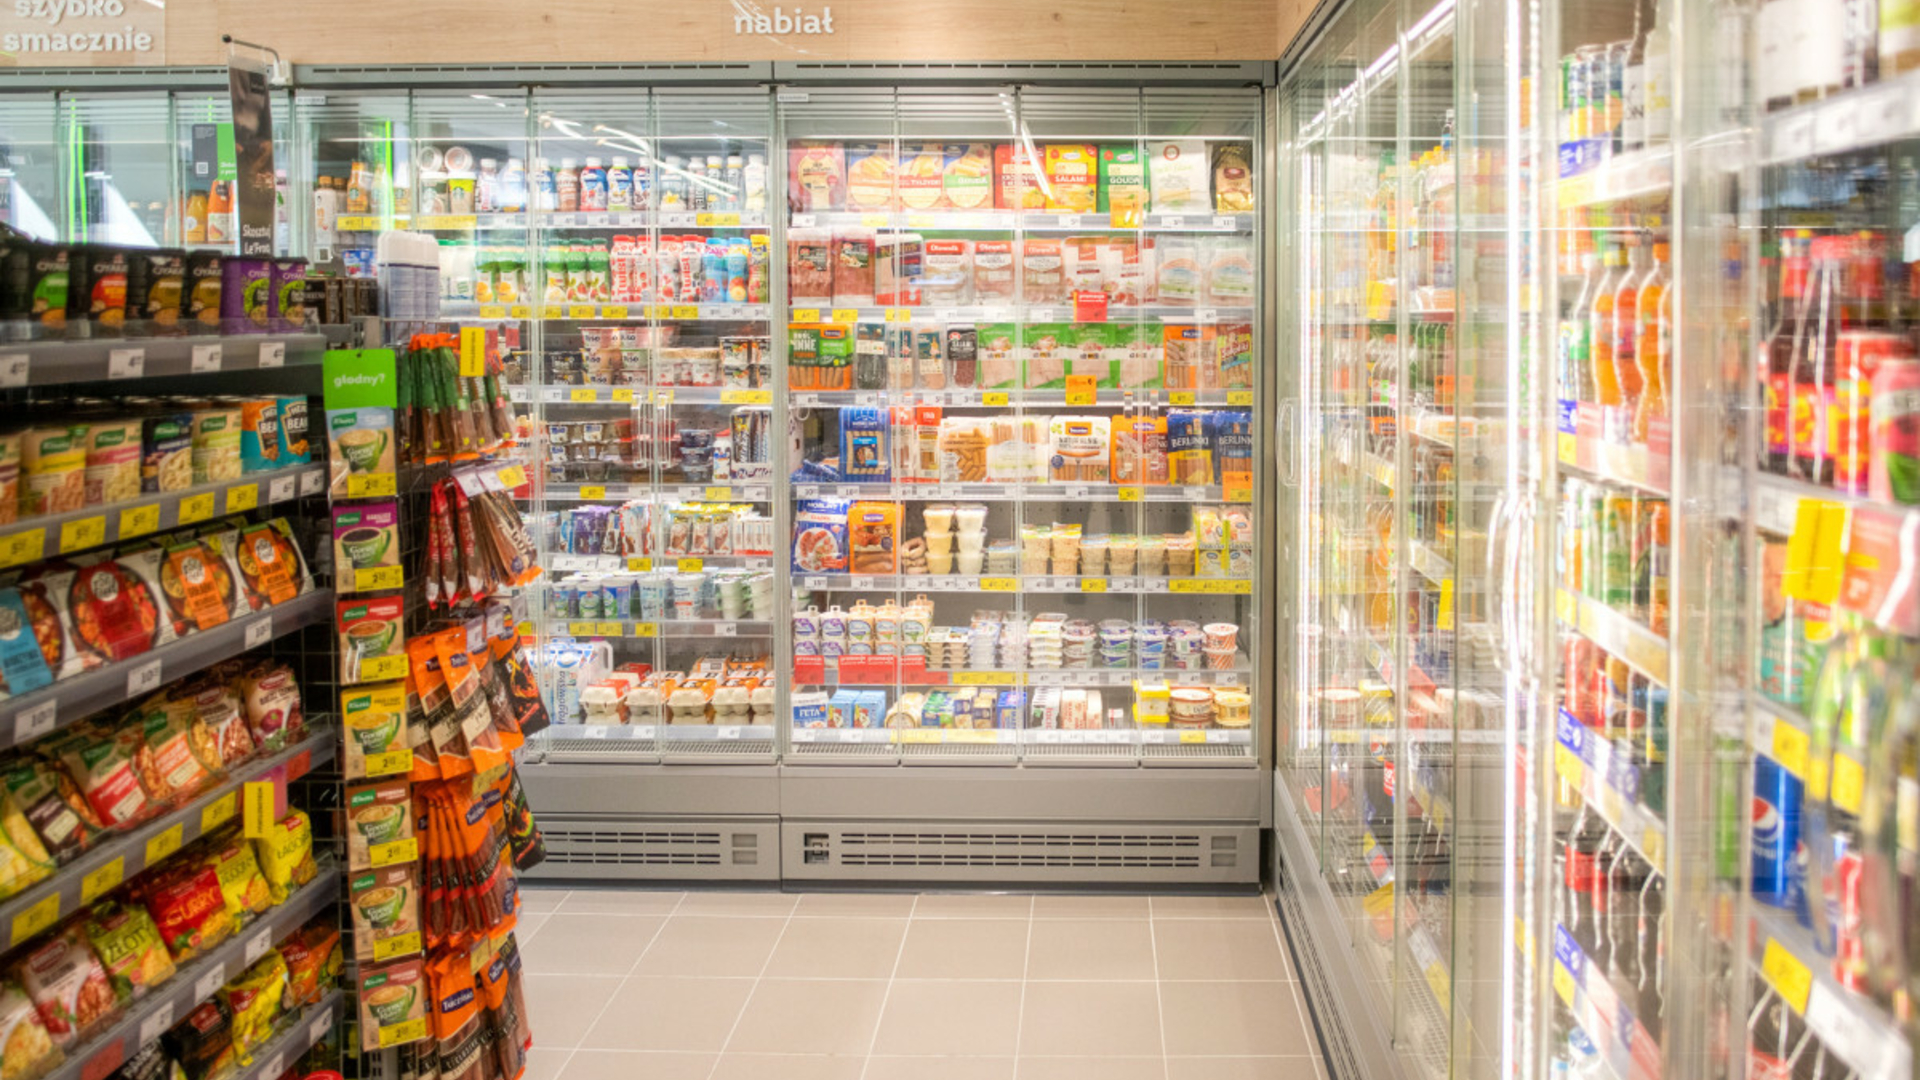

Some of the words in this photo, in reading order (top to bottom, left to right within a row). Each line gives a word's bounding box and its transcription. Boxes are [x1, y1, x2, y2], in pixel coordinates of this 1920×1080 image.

[15, 0, 125, 26] szybko
[3, 25, 154, 52] smacznie
[333, 374, 385, 387] głodny?
[799, 708, 820, 717] FETA
[164, 886, 219, 926] CURRY
